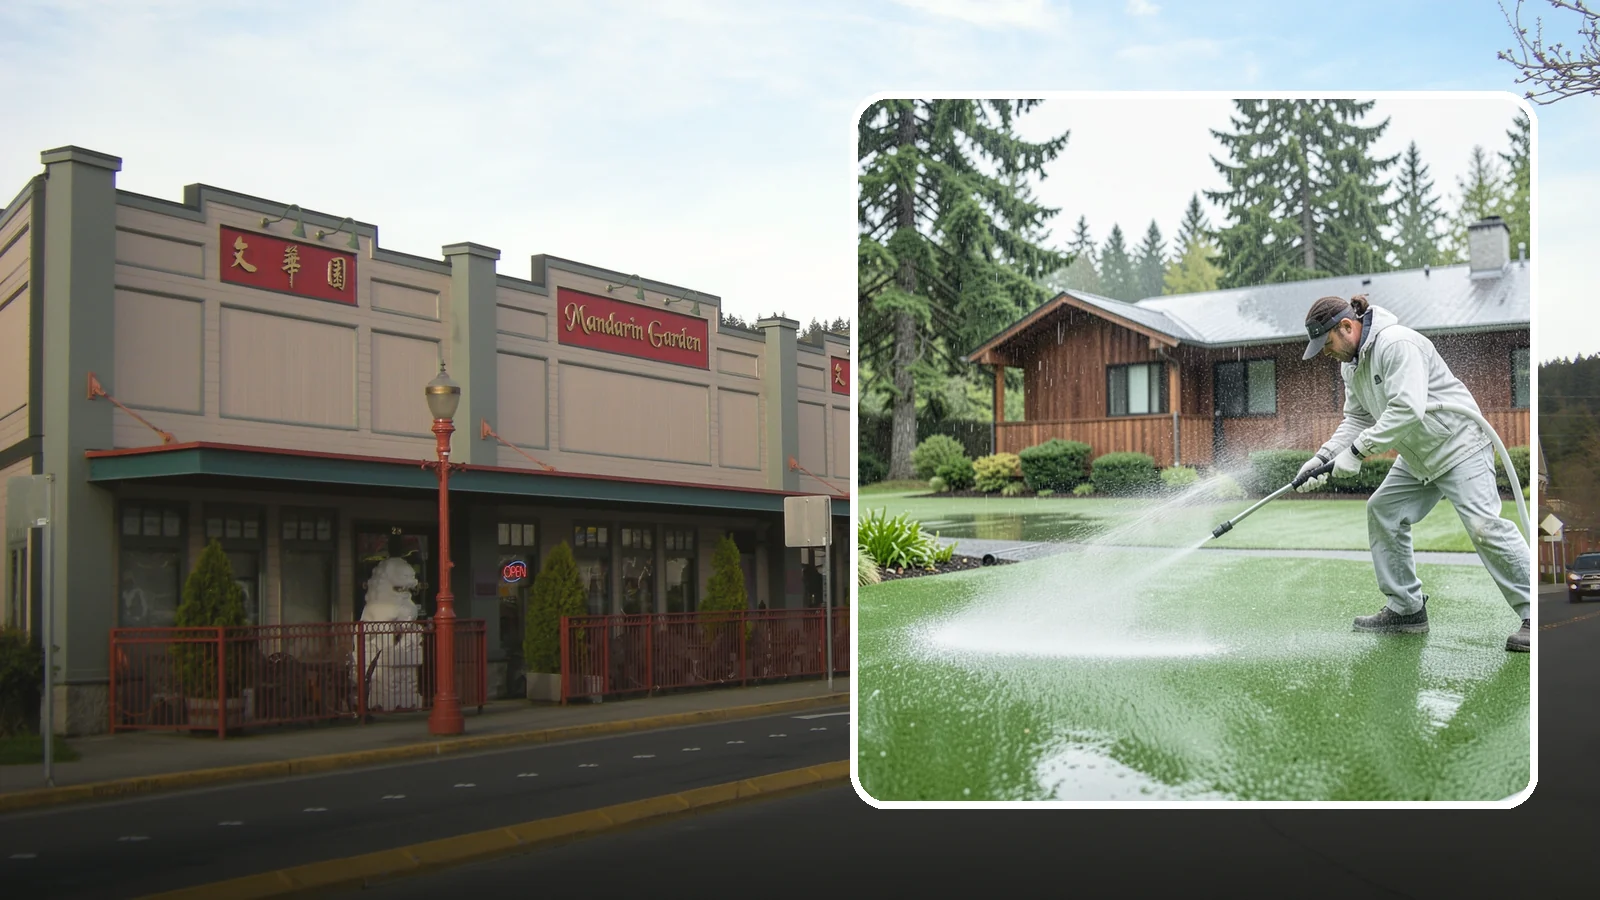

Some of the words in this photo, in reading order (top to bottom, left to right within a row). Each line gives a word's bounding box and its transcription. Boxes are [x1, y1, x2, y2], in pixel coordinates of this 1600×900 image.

[231, 235, 346, 291] 文華園
[564, 302, 644, 341] Mandarin
[648, 320, 701, 352] Garden
[391, 526, 402, 536] 28
[503, 565, 527, 578] OPEN
